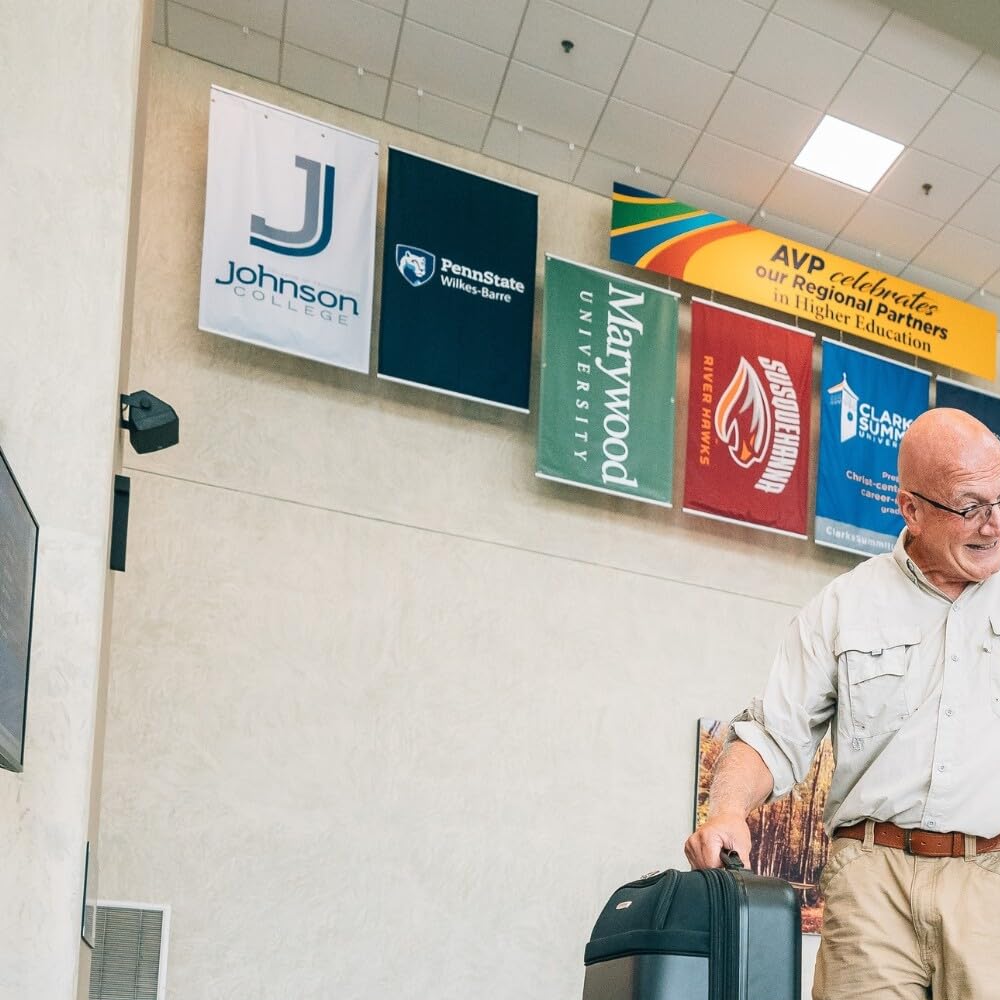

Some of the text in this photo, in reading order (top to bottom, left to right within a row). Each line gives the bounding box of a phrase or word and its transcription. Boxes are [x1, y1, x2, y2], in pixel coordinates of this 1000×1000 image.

[215, 261, 359, 316] Johnson
[233, 286, 349, 326] COLLEGE
[440, 274, 512, 303] Wilkes-Barre
[755, 265, 948, 340] our Regional Partners
[770, 244, 940, 316] AVP celebrates
[773, 288, 932, 353] in Higher Education
[574, 290, 593, 462] UNIVERSITY
[595, 282, 645, 488] Marywood
[700, 355, 714, 466] RIVER HAWKS
[754, 355, 800, 494] SUSQUEHANNA
[858, 430, 898, 448] UNIVER
[859, 403, 914, 430] CLARK
[859, 416, 906, 441] SUMM
[846, 470, 899, 493] Christ-cent
